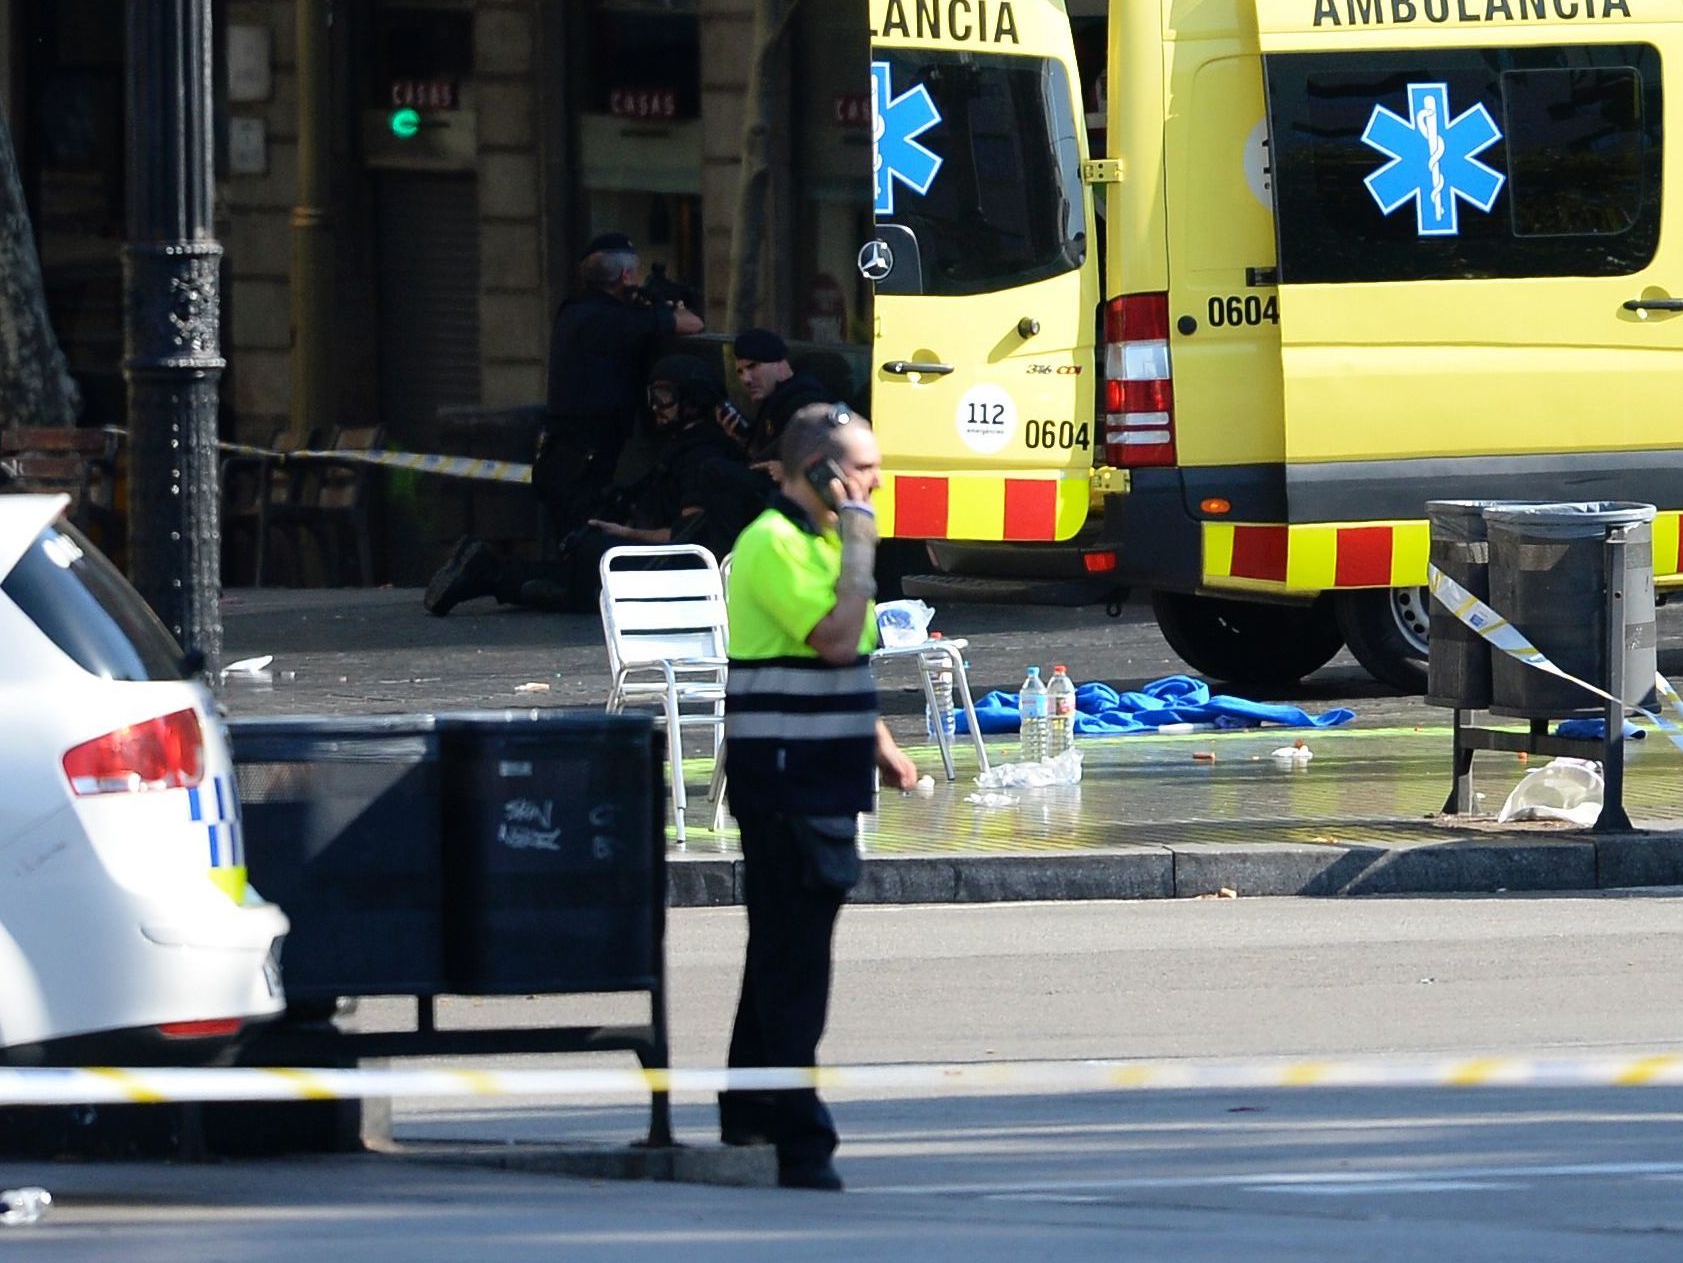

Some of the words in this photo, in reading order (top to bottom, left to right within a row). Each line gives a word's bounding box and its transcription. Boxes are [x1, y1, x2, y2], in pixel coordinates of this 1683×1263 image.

[1208, 296, 1281, 326] 0604
[967, 403, 1005, 425] 112
[1026, 420, 1091, 451] 0604
